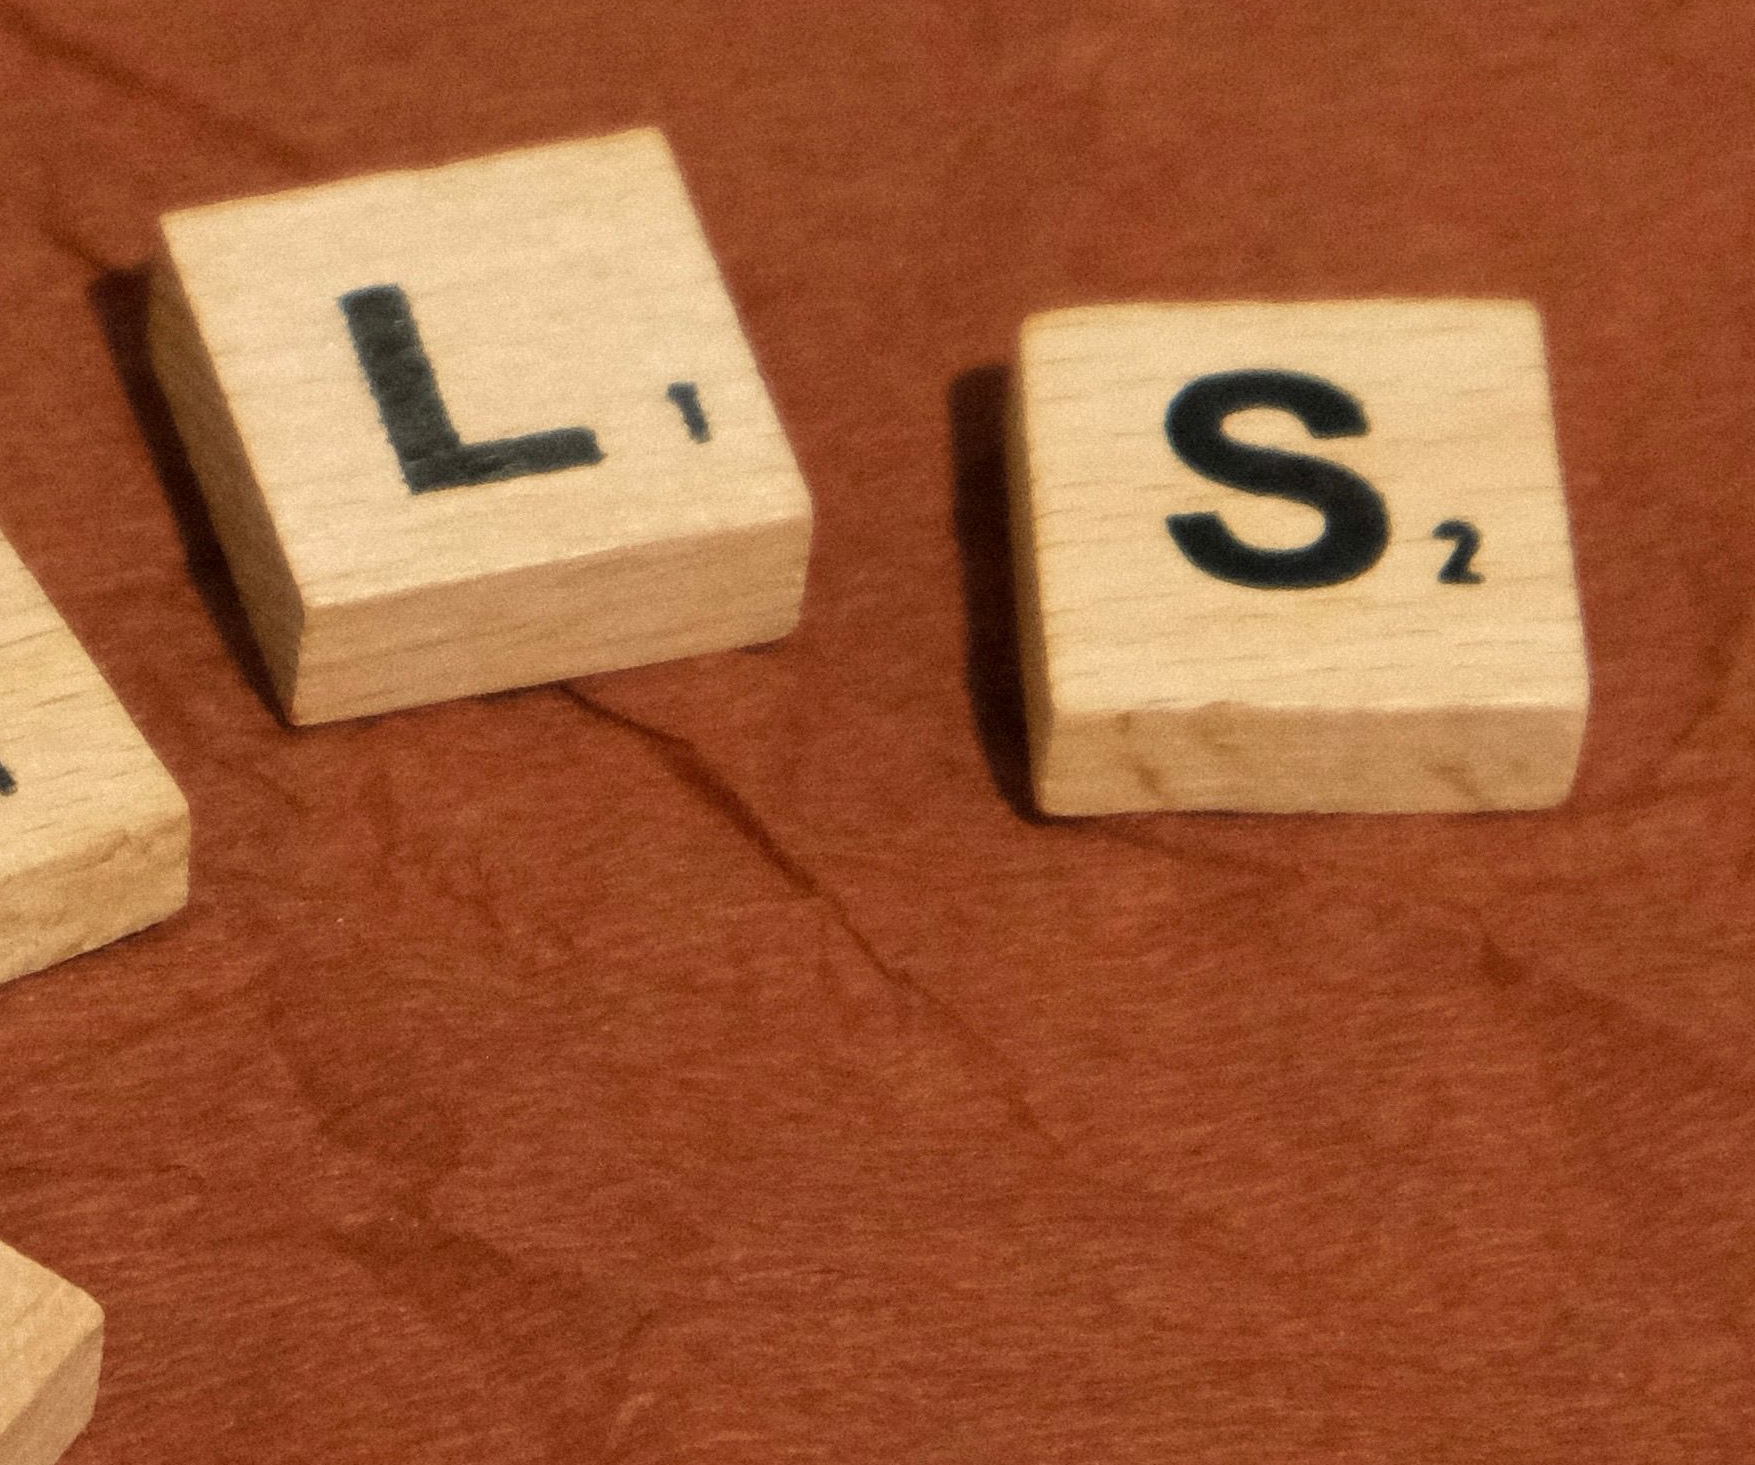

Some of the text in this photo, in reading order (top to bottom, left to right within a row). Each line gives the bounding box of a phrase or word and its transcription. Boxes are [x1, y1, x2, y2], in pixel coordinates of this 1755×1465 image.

[339, 284, 605, 497] L
[665, 381, 711, 445] 1
[1163, 368, 1392, 591] S
[1432, 518, 1484, 586] 2
